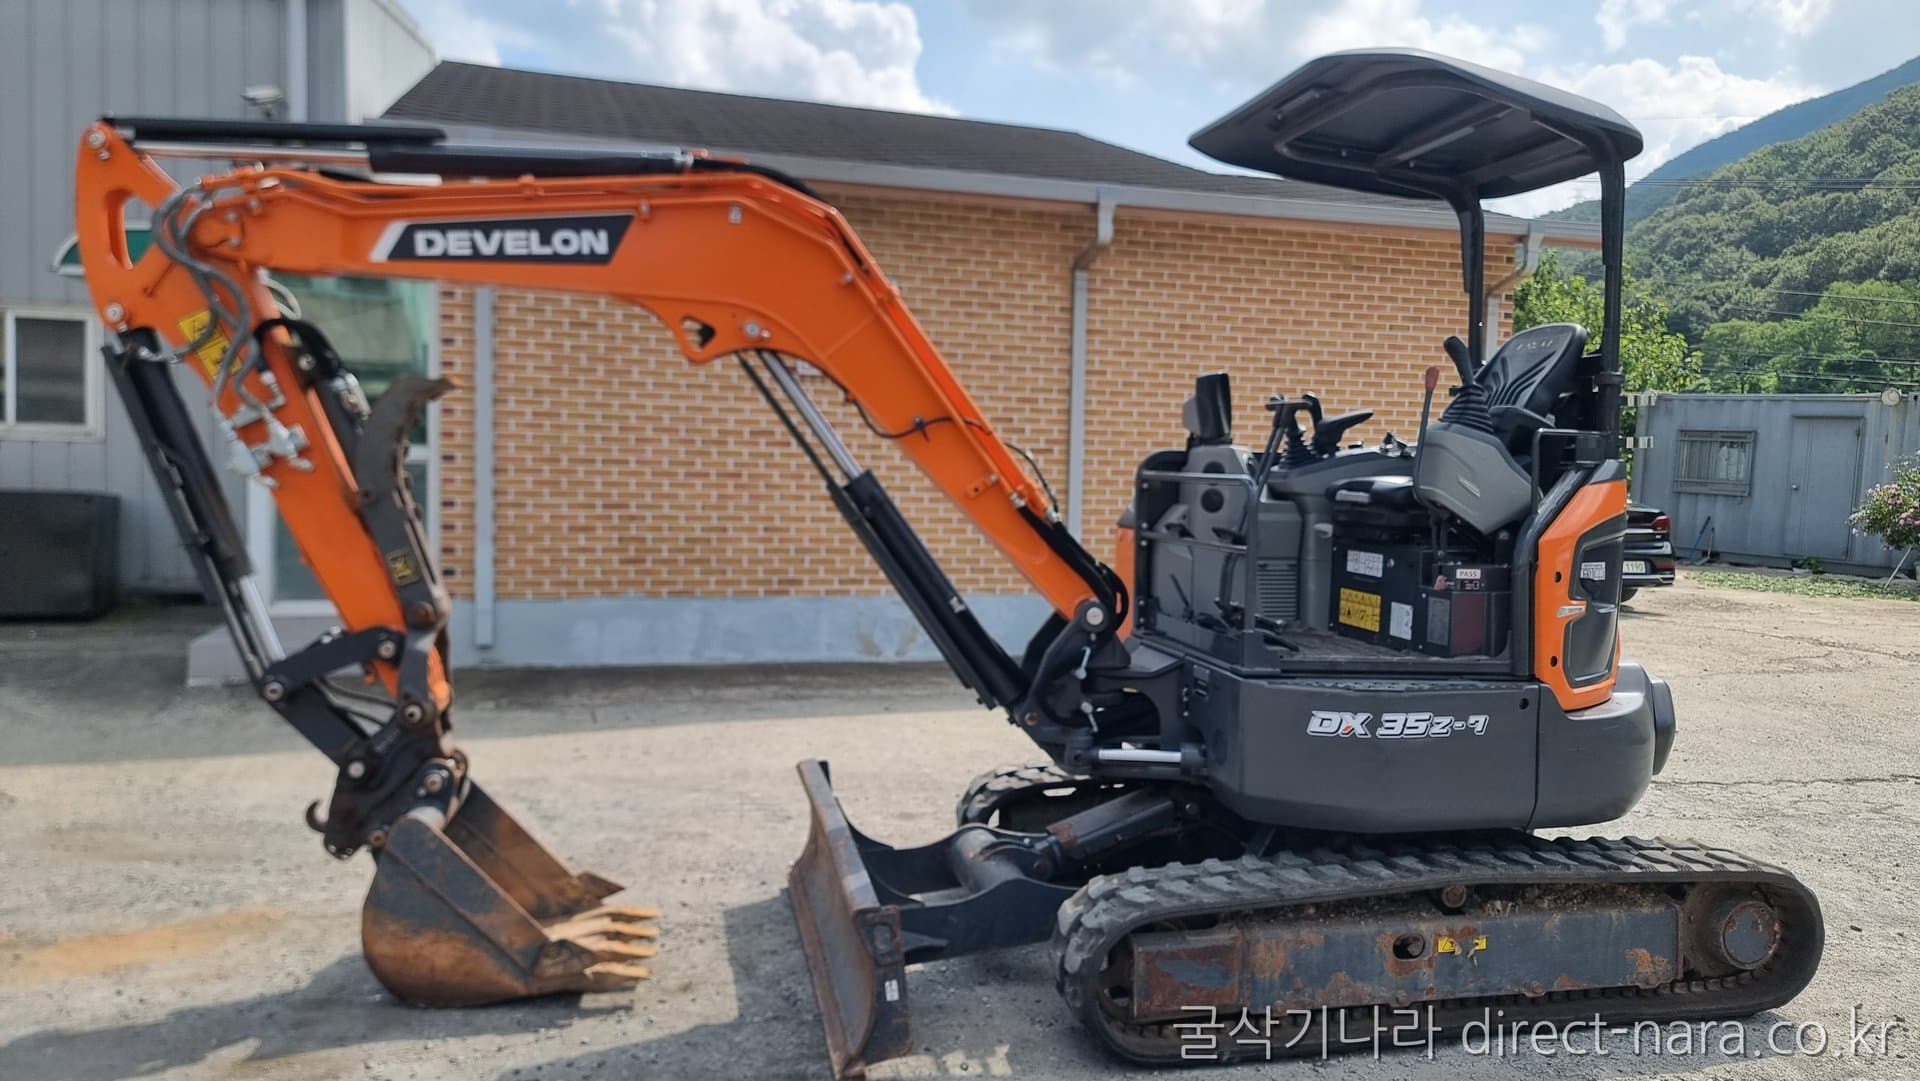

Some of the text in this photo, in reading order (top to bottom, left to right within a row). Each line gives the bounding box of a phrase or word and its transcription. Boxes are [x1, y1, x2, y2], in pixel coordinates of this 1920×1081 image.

[414, 229, 609, 256] DEVELON
[1459, 570, 1478, 578] PASS
[1307, 711, 1373, 737] DX
